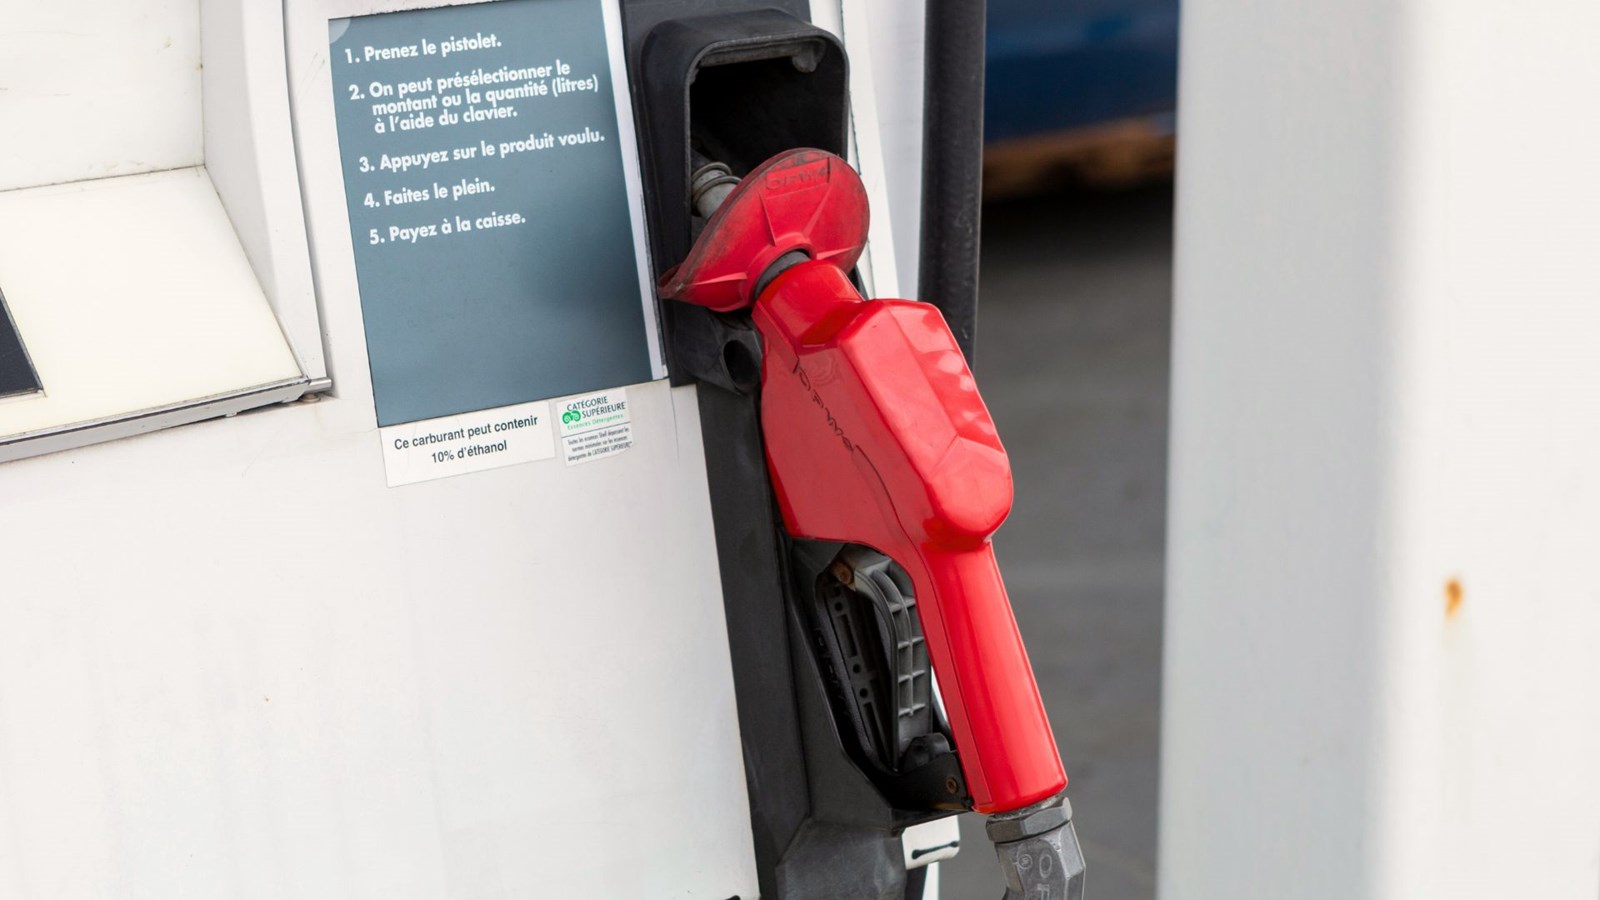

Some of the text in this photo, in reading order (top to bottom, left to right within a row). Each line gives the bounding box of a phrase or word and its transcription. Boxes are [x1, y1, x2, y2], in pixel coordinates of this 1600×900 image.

[344, 32, 502, 64] 1. Prenez le pistolet.
[348, 58, 571, 101] 2. On peut présélectionner le
[372, 74, 598, 116] montant ou la quantité (litres)
[374, 107, 518, 134] à l'aide du clavier.
[358, 126, 605, 173] 3. Appuyez sur le produit voulu.
[363, 177, 496, 208] 4. Faites le plein.
[369, 211, 526, 245] 5. Payez à la caisse.
[567, 396, 608, 411] CATÉGORIE
[582, 402, 626, 418] SUPÉRIEURE
[394, 415, 538, 450] Ce carburant peut contenir
[432, 439, 507, 463] 10% d'éthanol
